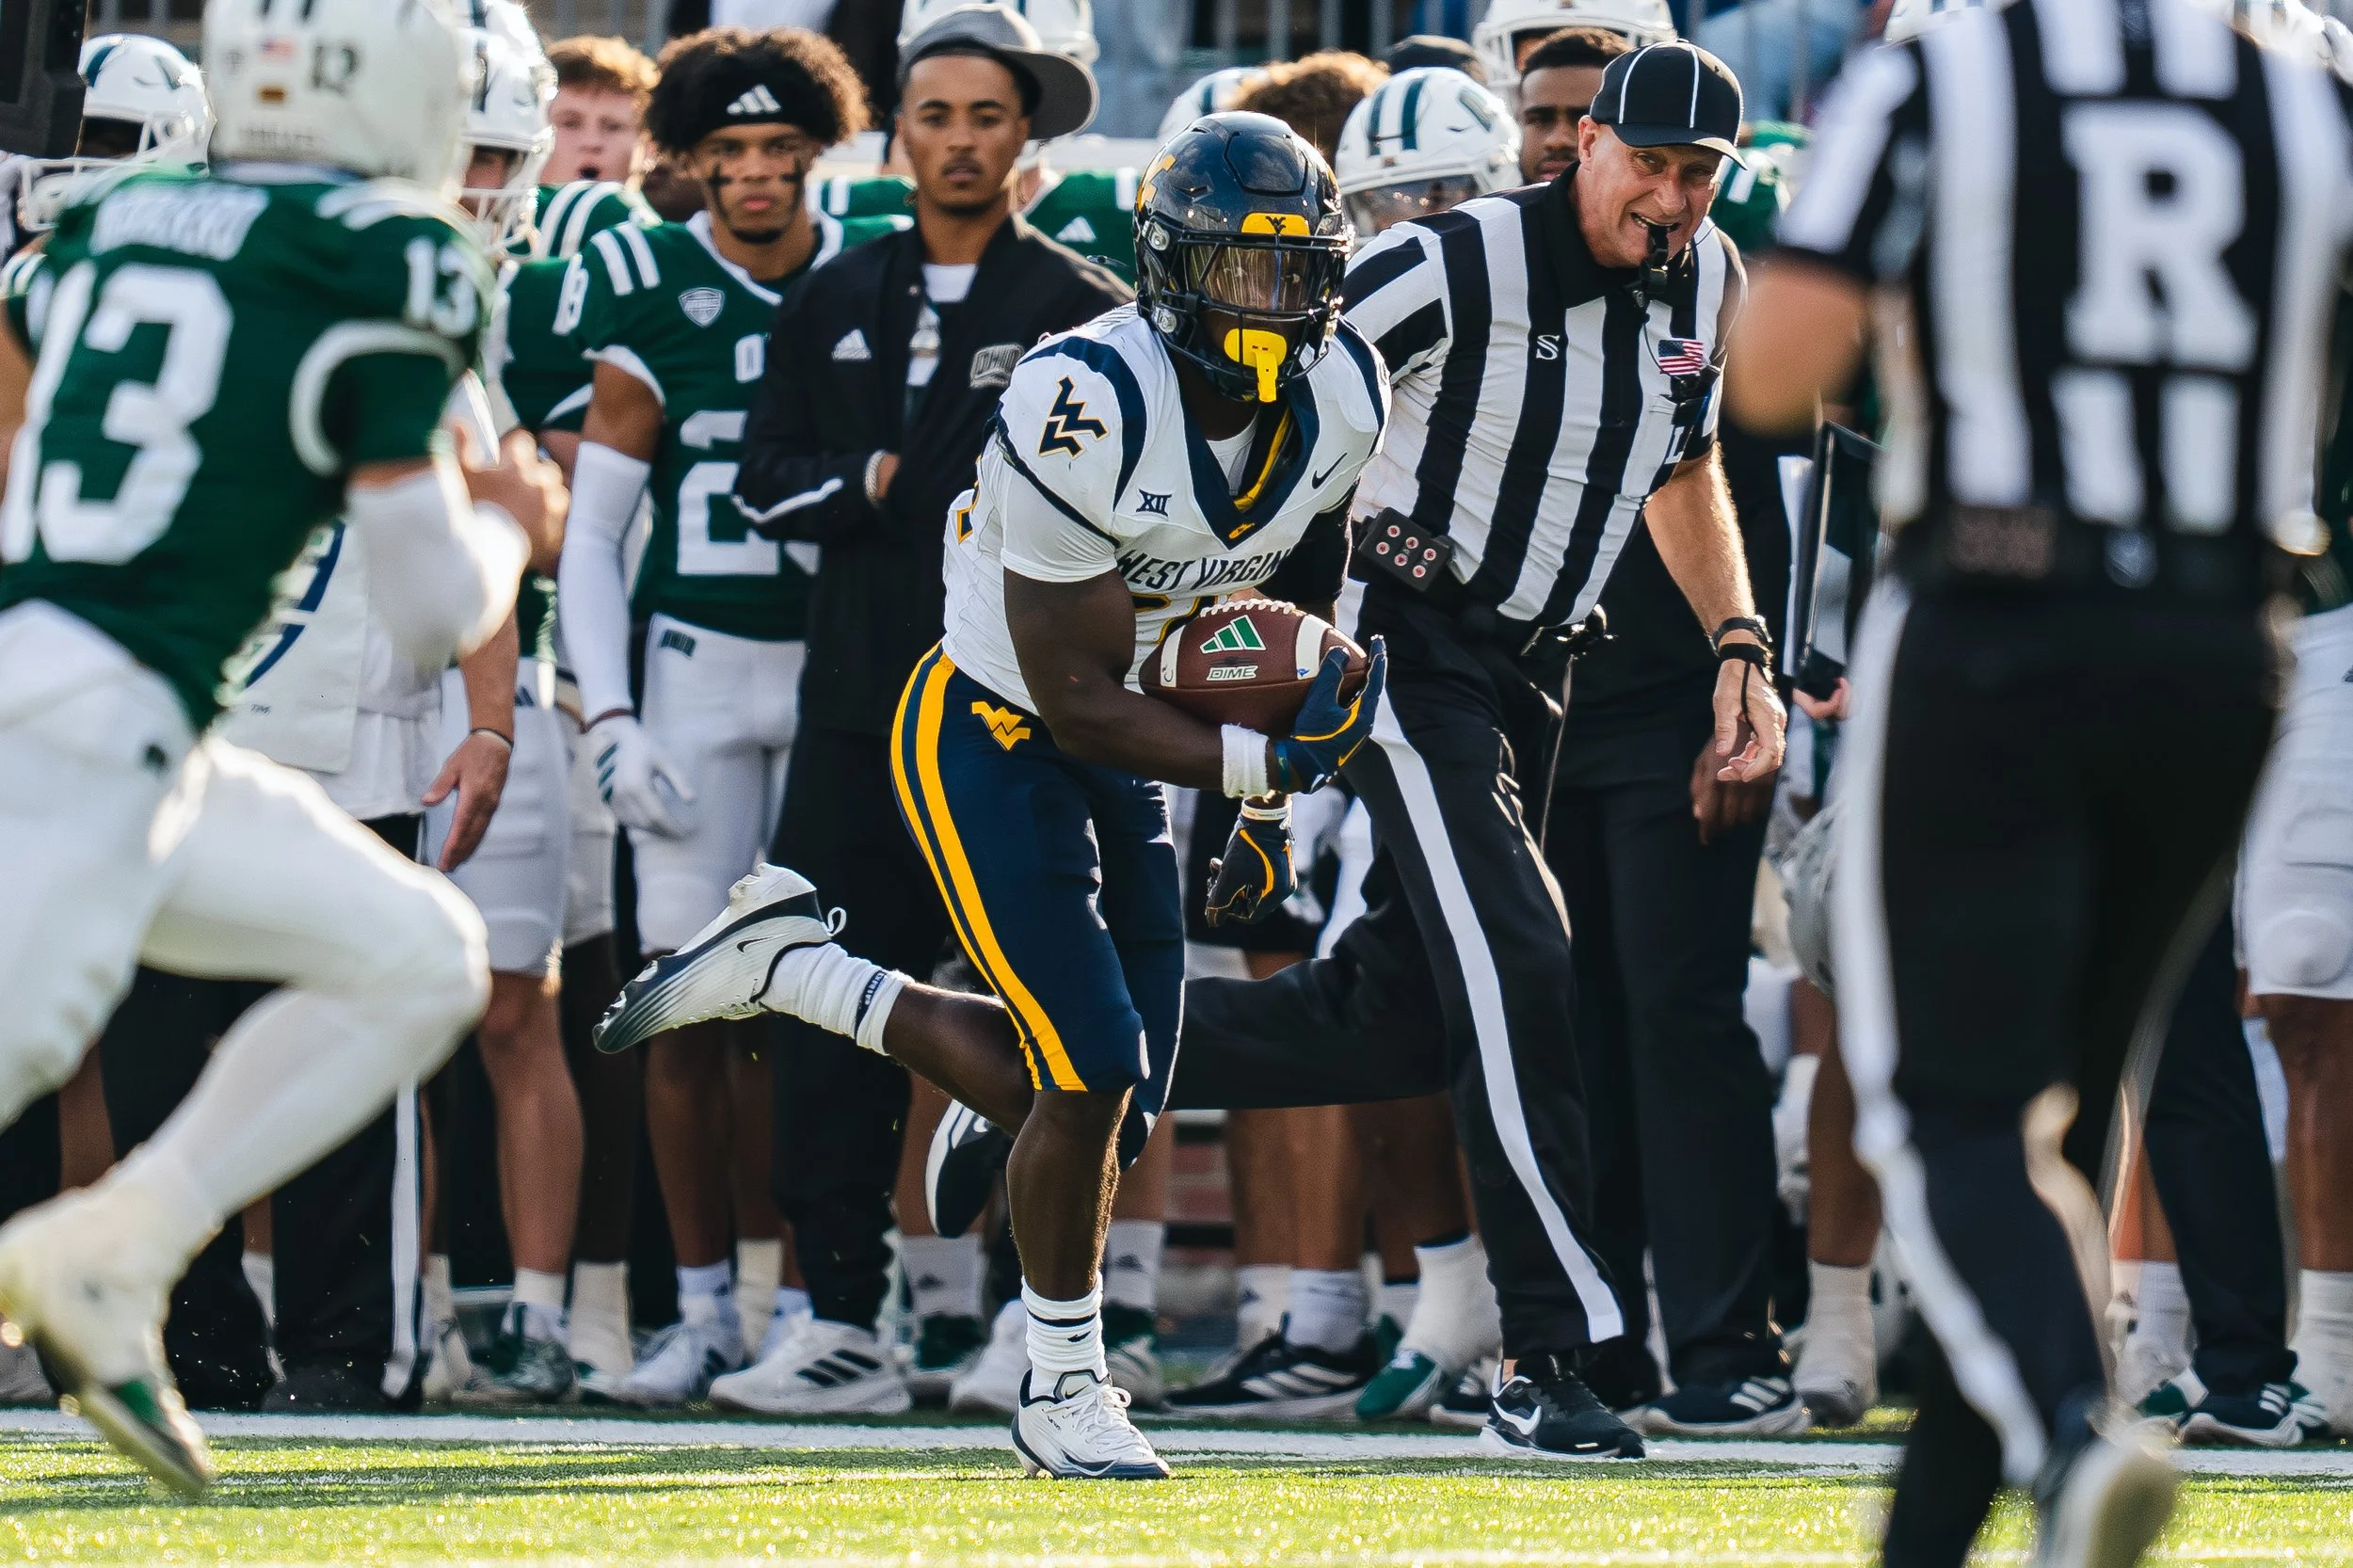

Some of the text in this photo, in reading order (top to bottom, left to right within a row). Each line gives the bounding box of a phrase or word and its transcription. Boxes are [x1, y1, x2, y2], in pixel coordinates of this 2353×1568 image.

[2063, 99, 2259, 372] R
[405, 236, 477, 335] 13
[1, 260, 233, 564] 13
[1135, 488, 1173, 517] XII
[1116, 547, 1291, 591] WEST VIRGIN
[1207, 665, 1258, 680] DIME
